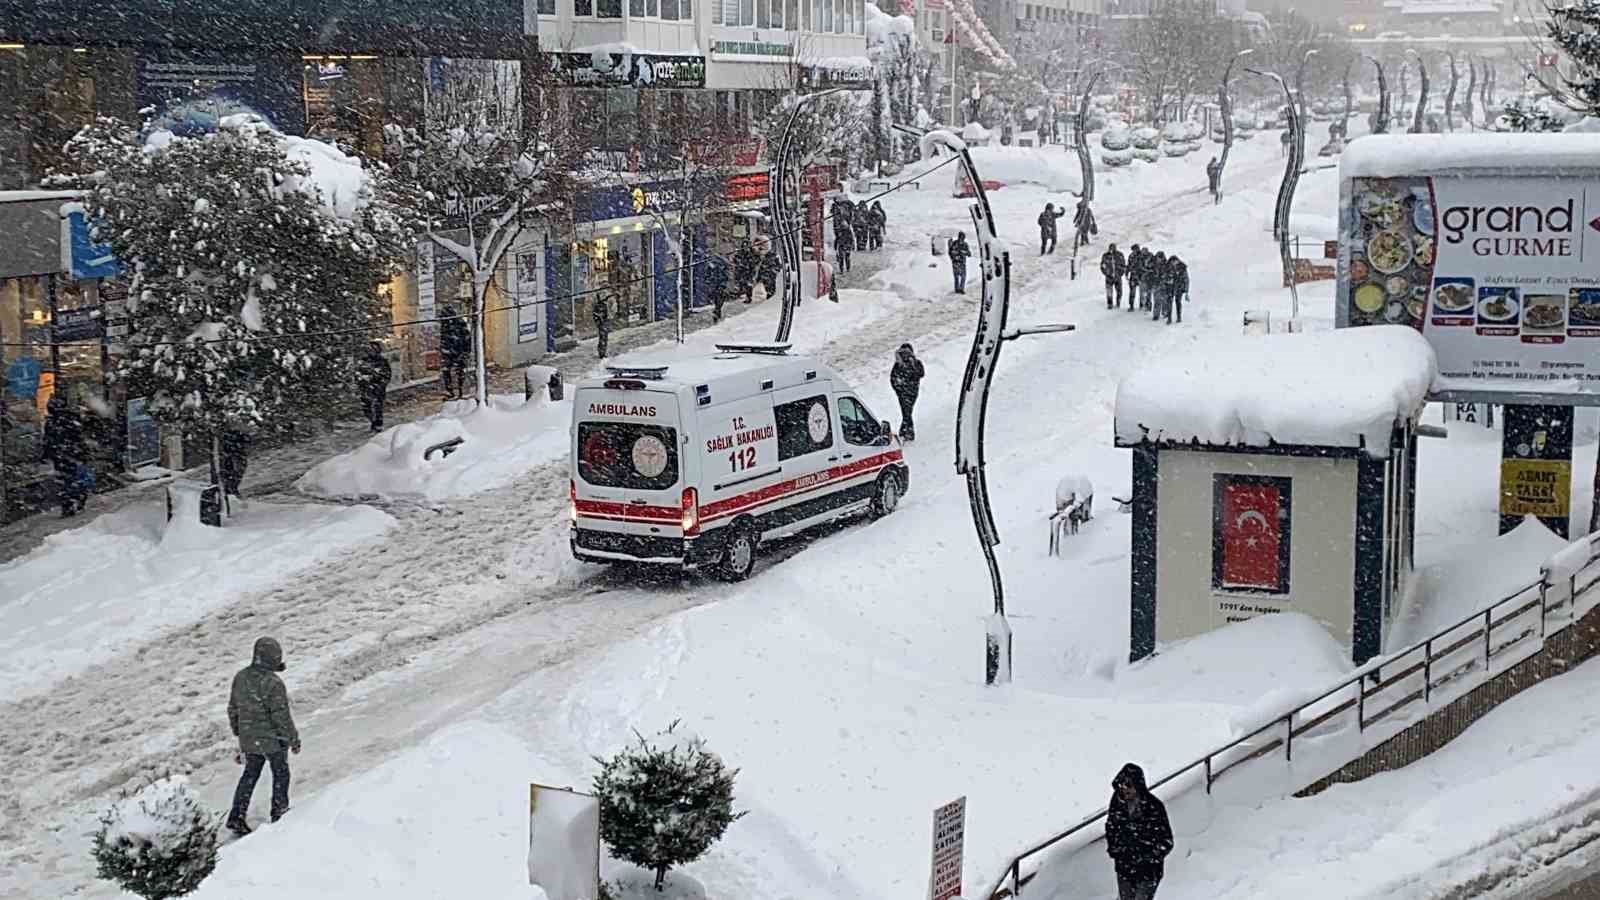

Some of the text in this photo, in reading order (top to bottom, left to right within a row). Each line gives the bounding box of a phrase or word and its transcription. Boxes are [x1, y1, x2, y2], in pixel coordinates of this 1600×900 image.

[1443, 198, 1574, 244] grand
[1473, 237, 1572, 256] GURME
[588, 403, 657, 417] AMBULANS
[706, 433, 734, 453] SAĞLIK
[728, 446, 757, 473] 112
[795, 471, 830, 489] AMBULANS
